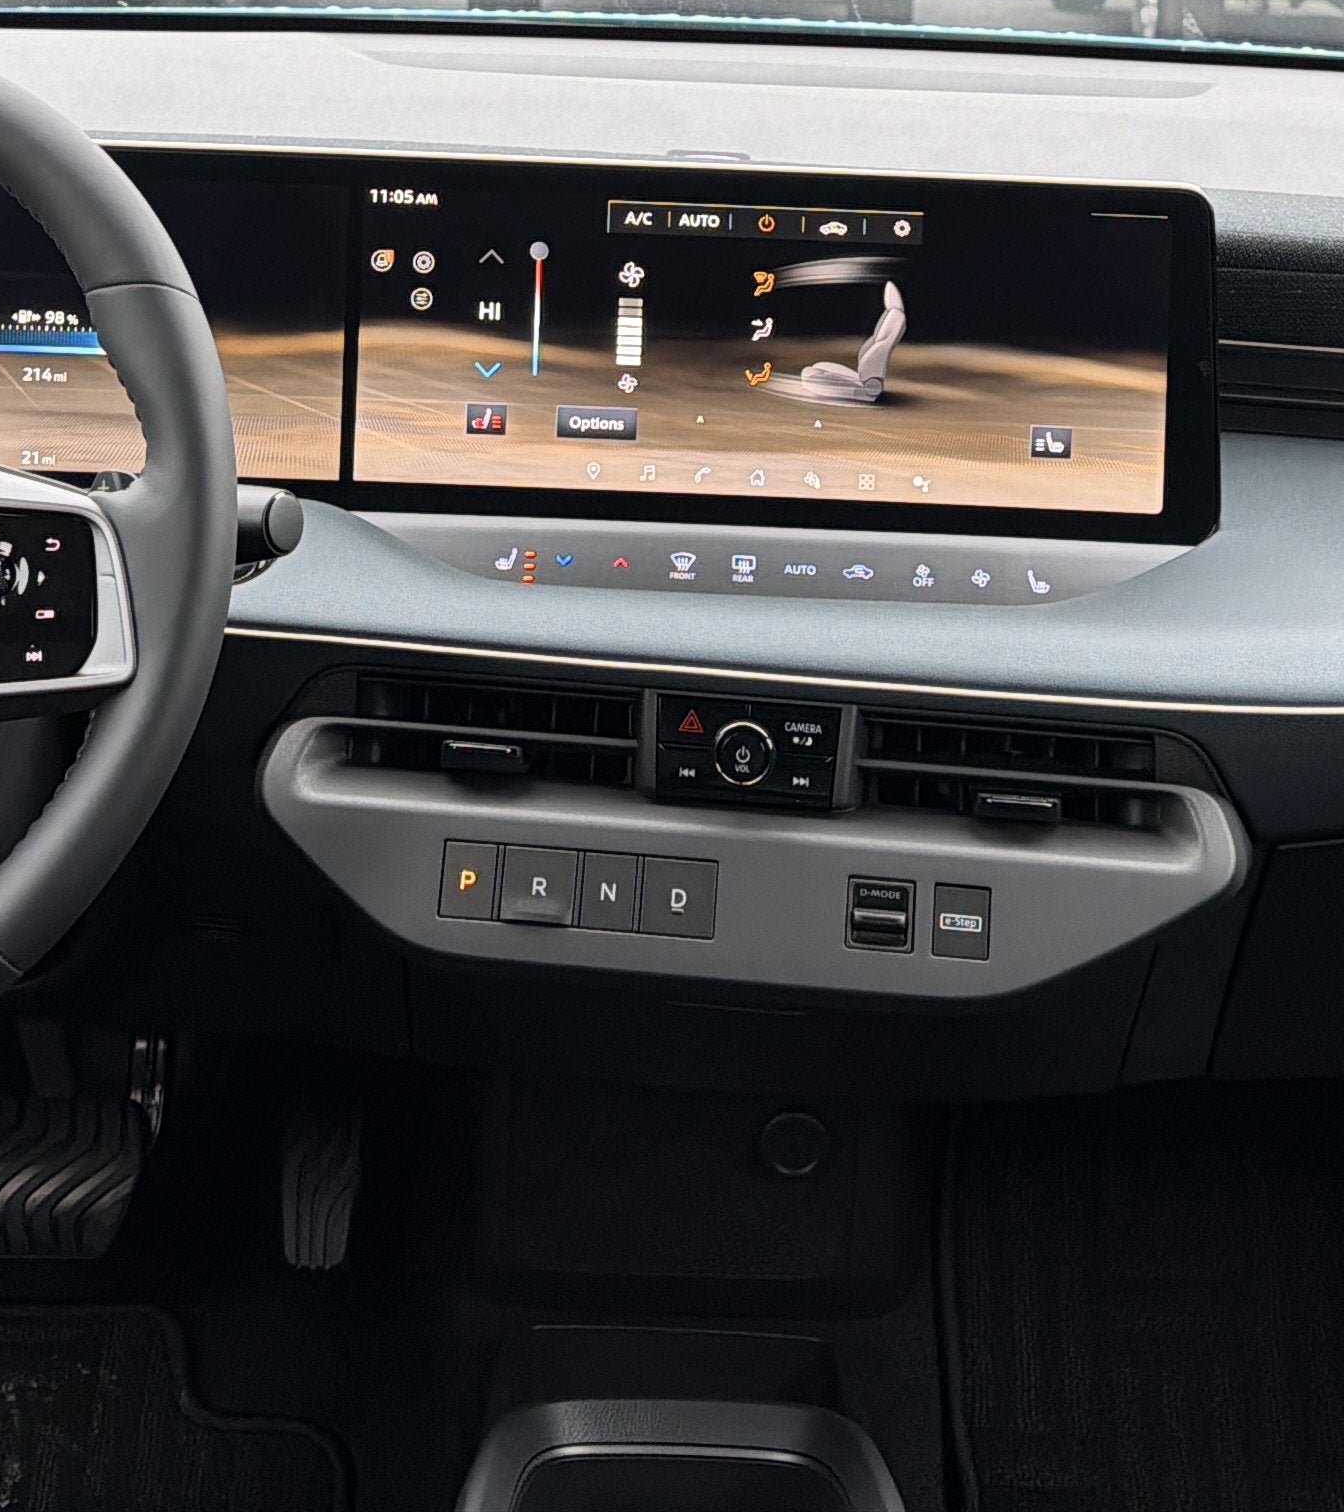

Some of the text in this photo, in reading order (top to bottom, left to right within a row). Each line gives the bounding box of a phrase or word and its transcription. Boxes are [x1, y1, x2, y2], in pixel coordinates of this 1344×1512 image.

[369, 188, 438, 205] 11:05 AM
[624, 211, 653, 227] A/C
[678, 213, 721, 229] AUTO
[478, 300, 502, 321] HI
[568, 415, 625, 433] Options
[669, 571, 697, 581] FRONT
[784, 564, 817, 576] AUTO
[912, 576, 935, 587] OFF
[784, 721, 822, 735] CAMERA
[734, 763, 751, 774] VOL
[459, 870, 477, 891] P
[531, 876, 548, 898] R
[600, 882, 616, 903] N
[670, 888, 688, 910] D
[859, 888, 902, 901] D-MODE
[944, 916, 978, 931] e-Step
